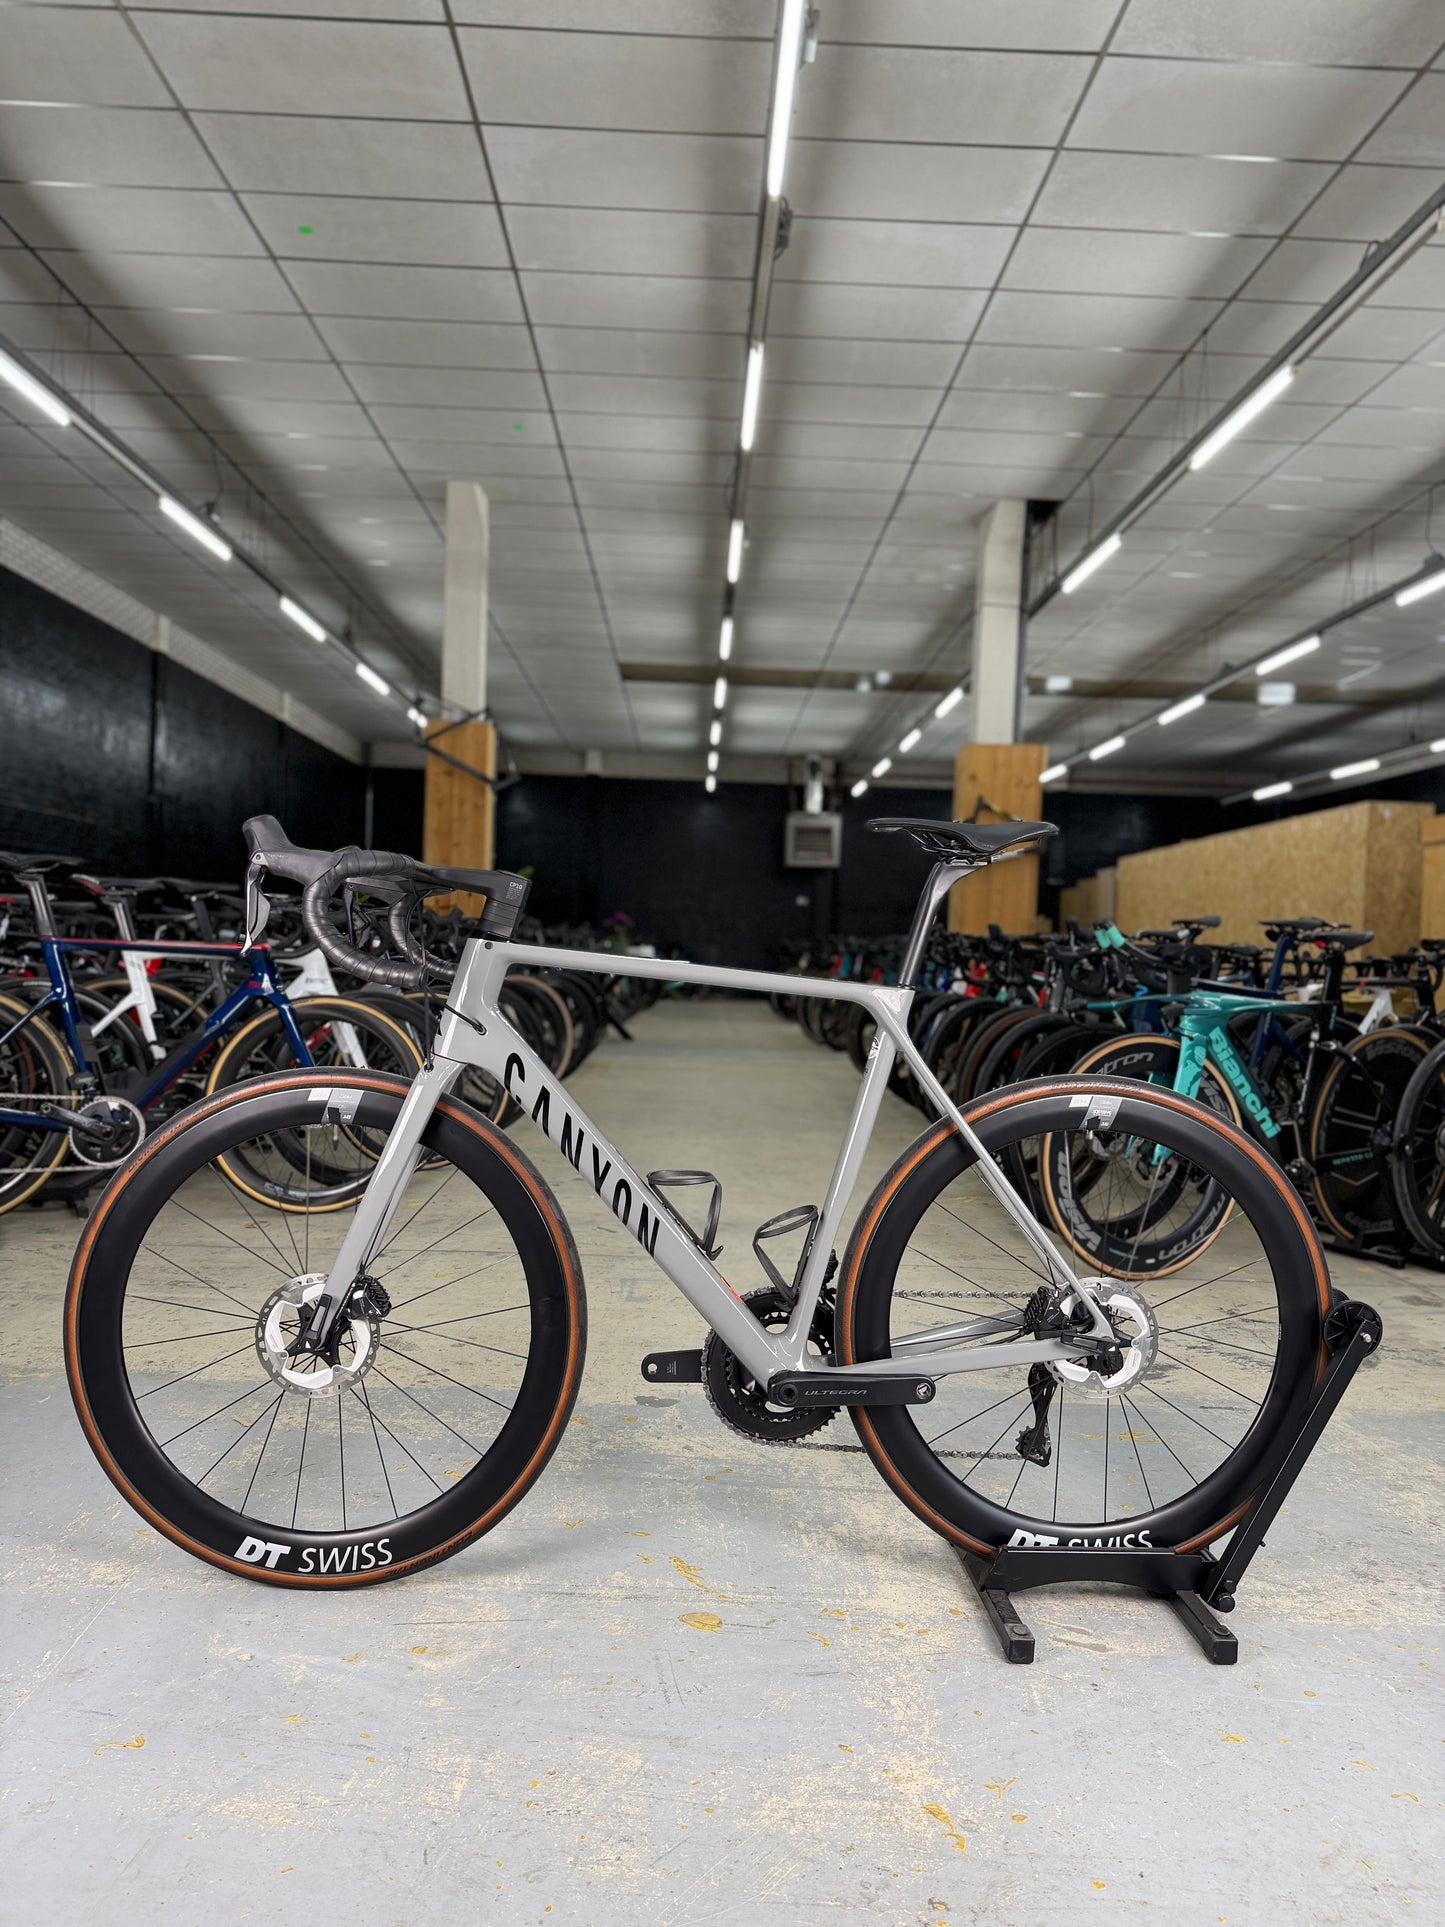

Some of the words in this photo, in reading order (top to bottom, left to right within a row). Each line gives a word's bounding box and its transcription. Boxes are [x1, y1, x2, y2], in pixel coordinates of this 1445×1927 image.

[510, 881, 523, 890] CP10
[1096, 1051, 1155, 1075] tron
[1209, 1026, 1282, 1138] Bianchi
[504, 1053, 660, 1258] CANYON
[234, 1536, 291, 1569] DT
[298, 1538, 393, 1573] SWISS
